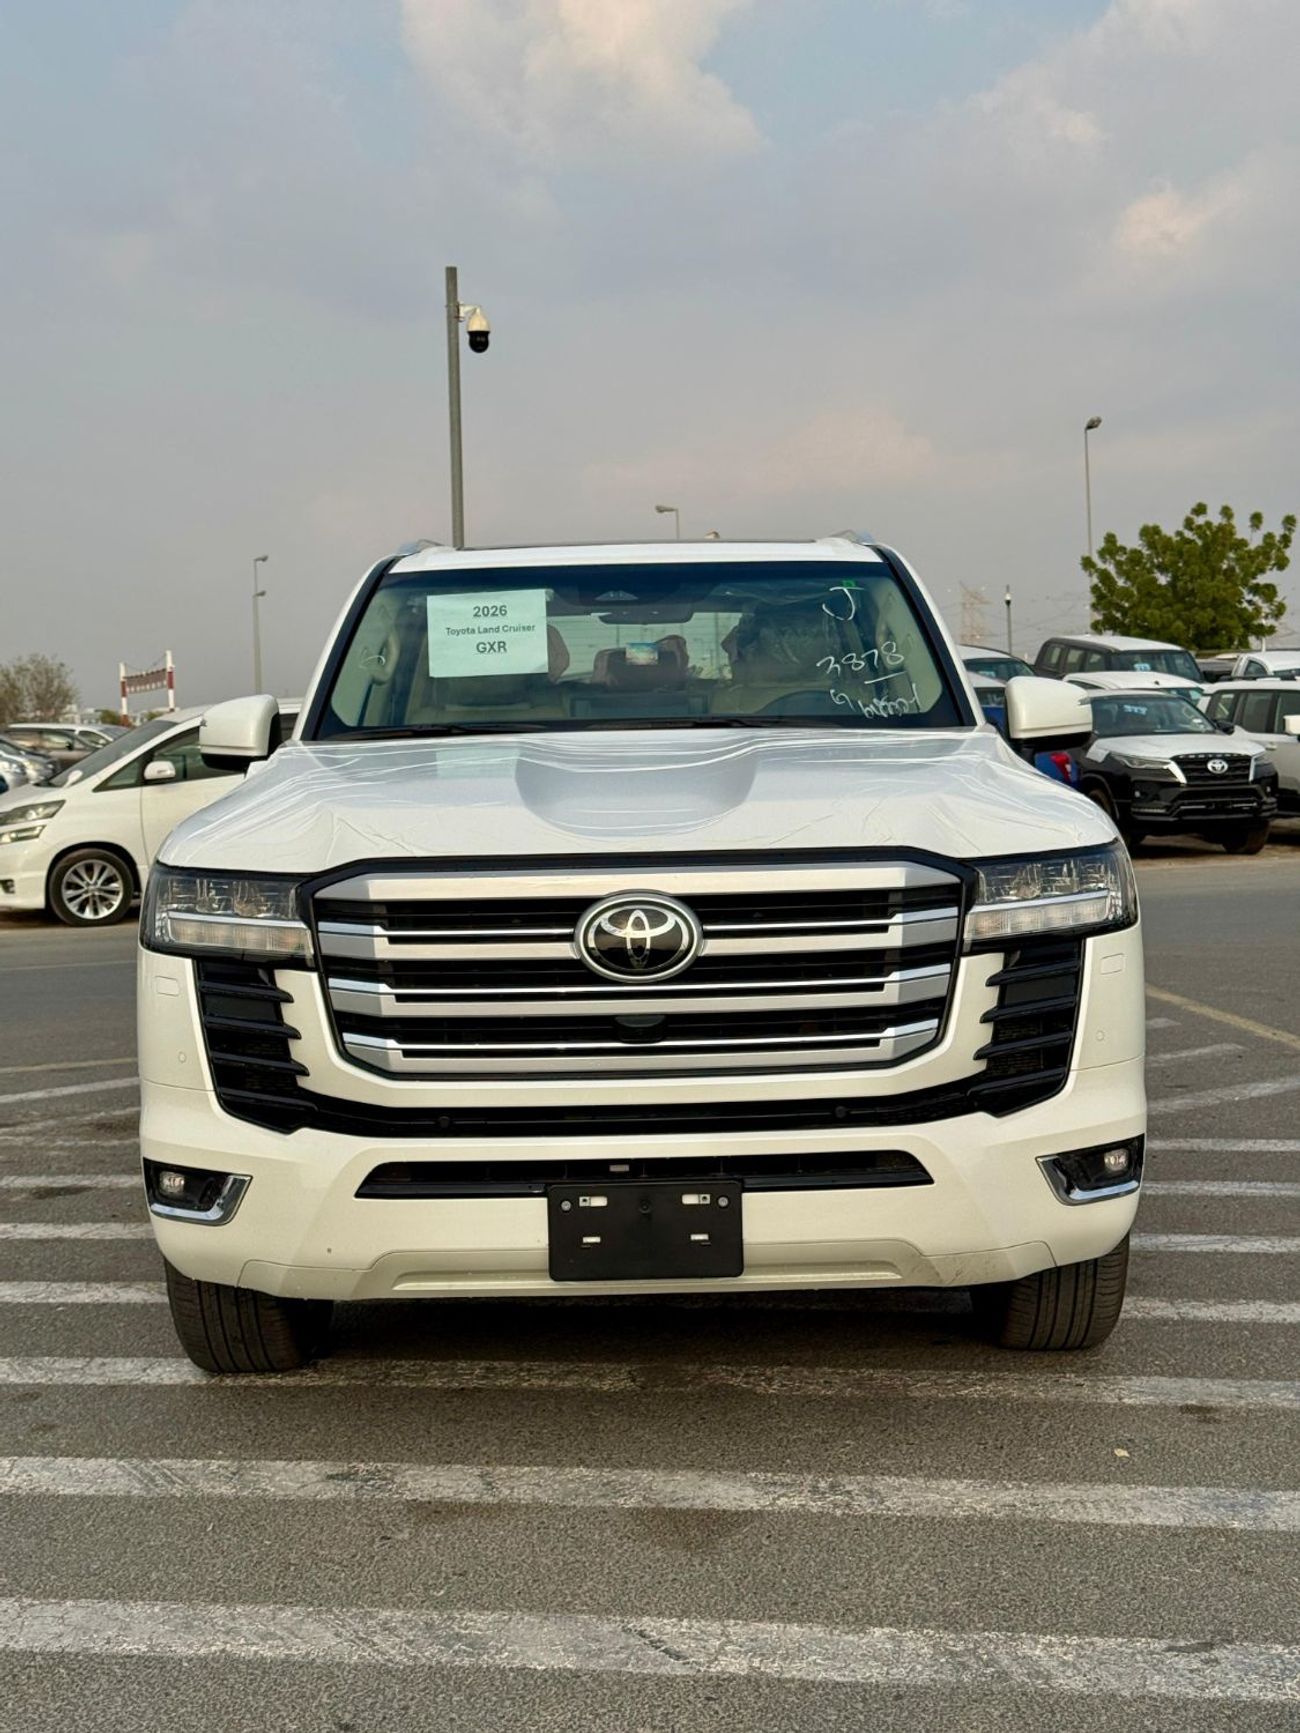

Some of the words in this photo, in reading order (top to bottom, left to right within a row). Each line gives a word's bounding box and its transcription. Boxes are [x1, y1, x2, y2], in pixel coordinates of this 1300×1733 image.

[473, 605, 508, 617] 2026
[446, 627, 476, 636] Toyota
[477, 625, 500, 634] Land
[502, 624, 536, 633] Cruiser
[476, 641, 507, 653] GXR
